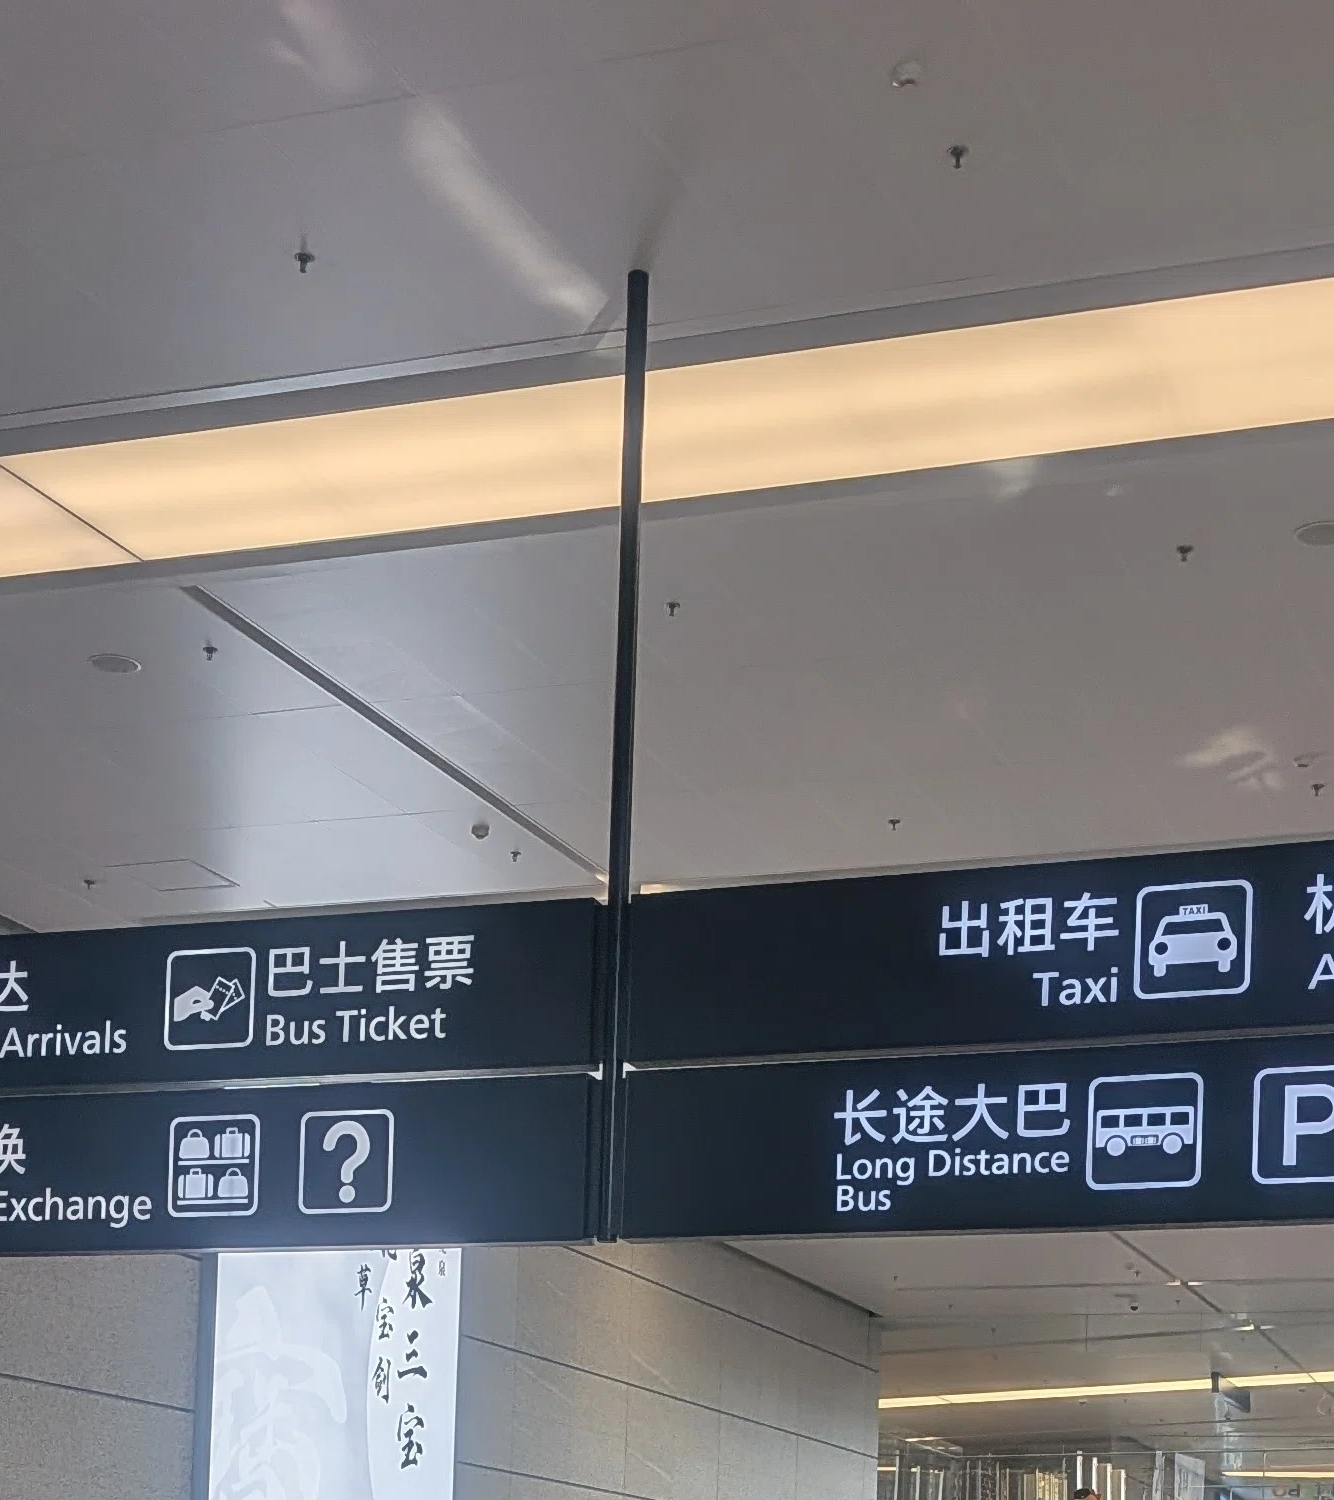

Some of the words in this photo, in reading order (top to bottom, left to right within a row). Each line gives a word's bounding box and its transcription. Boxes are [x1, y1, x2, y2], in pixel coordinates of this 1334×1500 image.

[939, 892, 1119, 957] 出租车
[268, 935, 474, 997] 巴士售票
[1033, 967, 1118, 1006] Taxi
[0, 1020, 126, 1058] Arrivals
[266, 1015, 325, 1046] Bus
[336, 1006, 446, 1042] Ticket
[834, 1083, 1070, 1145] 长途大巴
[836, 1154, 915, 1185] Long
[929, 1148, 1069, 1176] Distance
[837, 1185, 891, 1211] Bus
